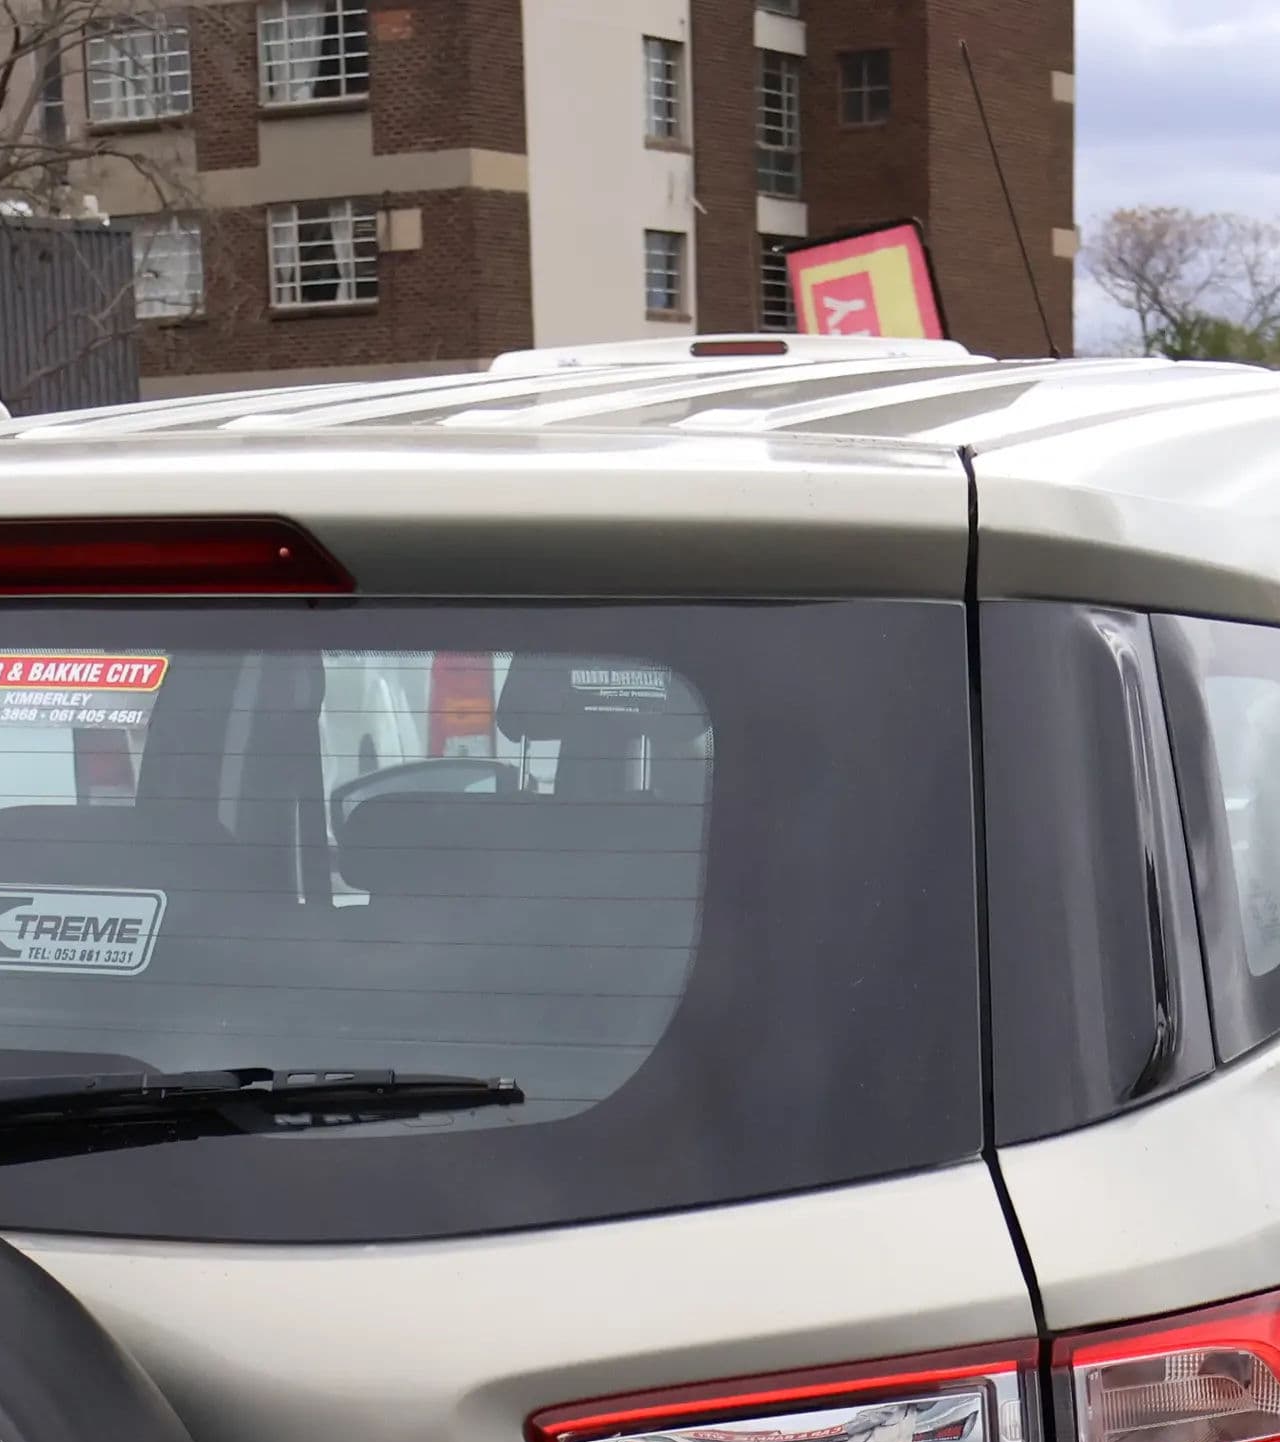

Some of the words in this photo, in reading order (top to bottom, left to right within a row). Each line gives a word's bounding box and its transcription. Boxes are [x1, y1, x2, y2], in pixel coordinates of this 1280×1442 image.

[7, 662, 23, 681] &
[27, 662, 105, 682] BAKKIE
[106, 663, 158, 684] CITY
[3, 691, 93, 707] KIMBERLEY
[49, 709, 73, 722] 061
[77, 709, 105, 723] 405
[109, 710, 142, 724] 4581
[28, 946, 51, 960] TEL:
[54, 947, 77, 961] 053
